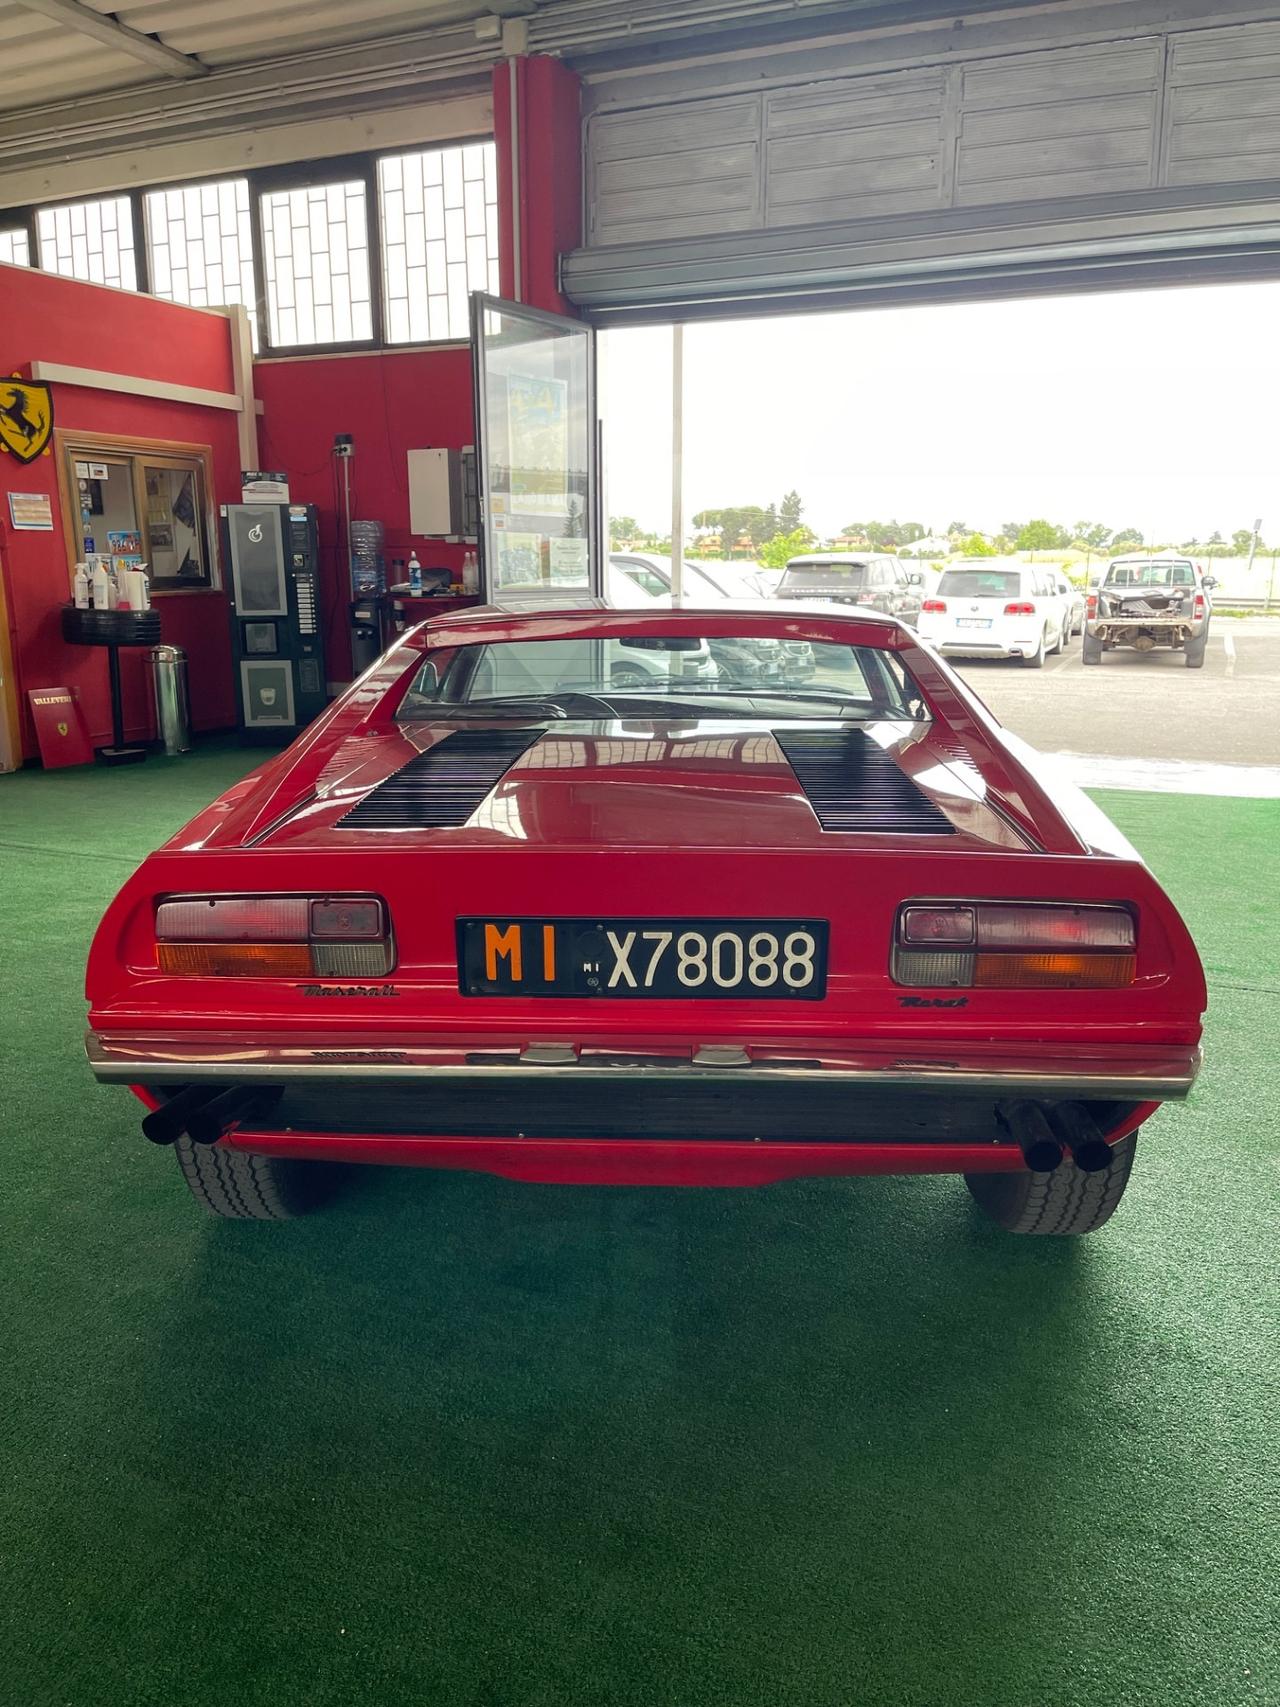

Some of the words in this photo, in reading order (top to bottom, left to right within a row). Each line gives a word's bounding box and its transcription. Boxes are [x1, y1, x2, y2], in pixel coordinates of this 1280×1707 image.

[606, 931, 816, 988] X78088
[583, 963, 600, 973] MI
[296, 984, 401, 997] Maserati
